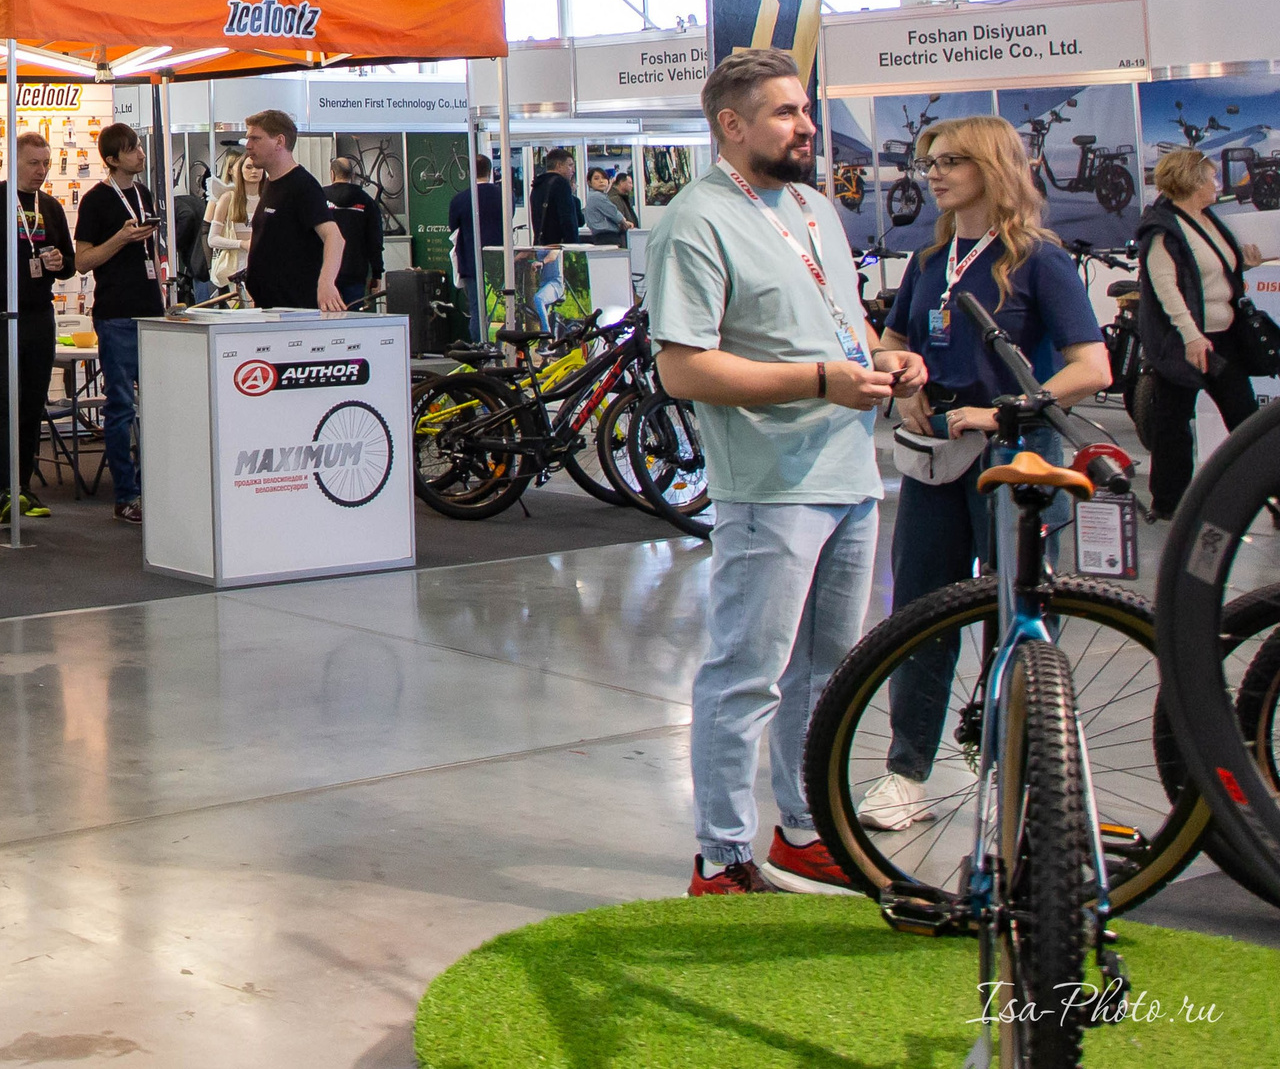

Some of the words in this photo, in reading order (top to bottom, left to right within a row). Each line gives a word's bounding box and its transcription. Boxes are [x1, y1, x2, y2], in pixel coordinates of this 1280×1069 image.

[908, 28, 967, 45] Foshan
[973, 24, 1047, 42] Disiyuan
[641, 51, 686, 65] Foshan
[879, 50, 938, 67] Electric
[942, 45, 1003, 62] Vehicle
[1009, 42, 1043, 60] Co.,
[1049, 39, 1083, 56] Ltd.
[1119, 58, 1145, 68] A8-19
[619, 69, 663, 84] Electric
[16, 83, 80, 106] IceToolz
[319, 98, 362, 108] Shenzhen
[365, 98, 384, 108] First
[386, 98, 436, 110] Technology
[438, 98, 468, 109] Co.,Ltd
[281, 364, 360, 379] AUTHOR
[281, 376, 358, 385] BICYCLES
[234, 441, 363, 476] MAXIMUM
